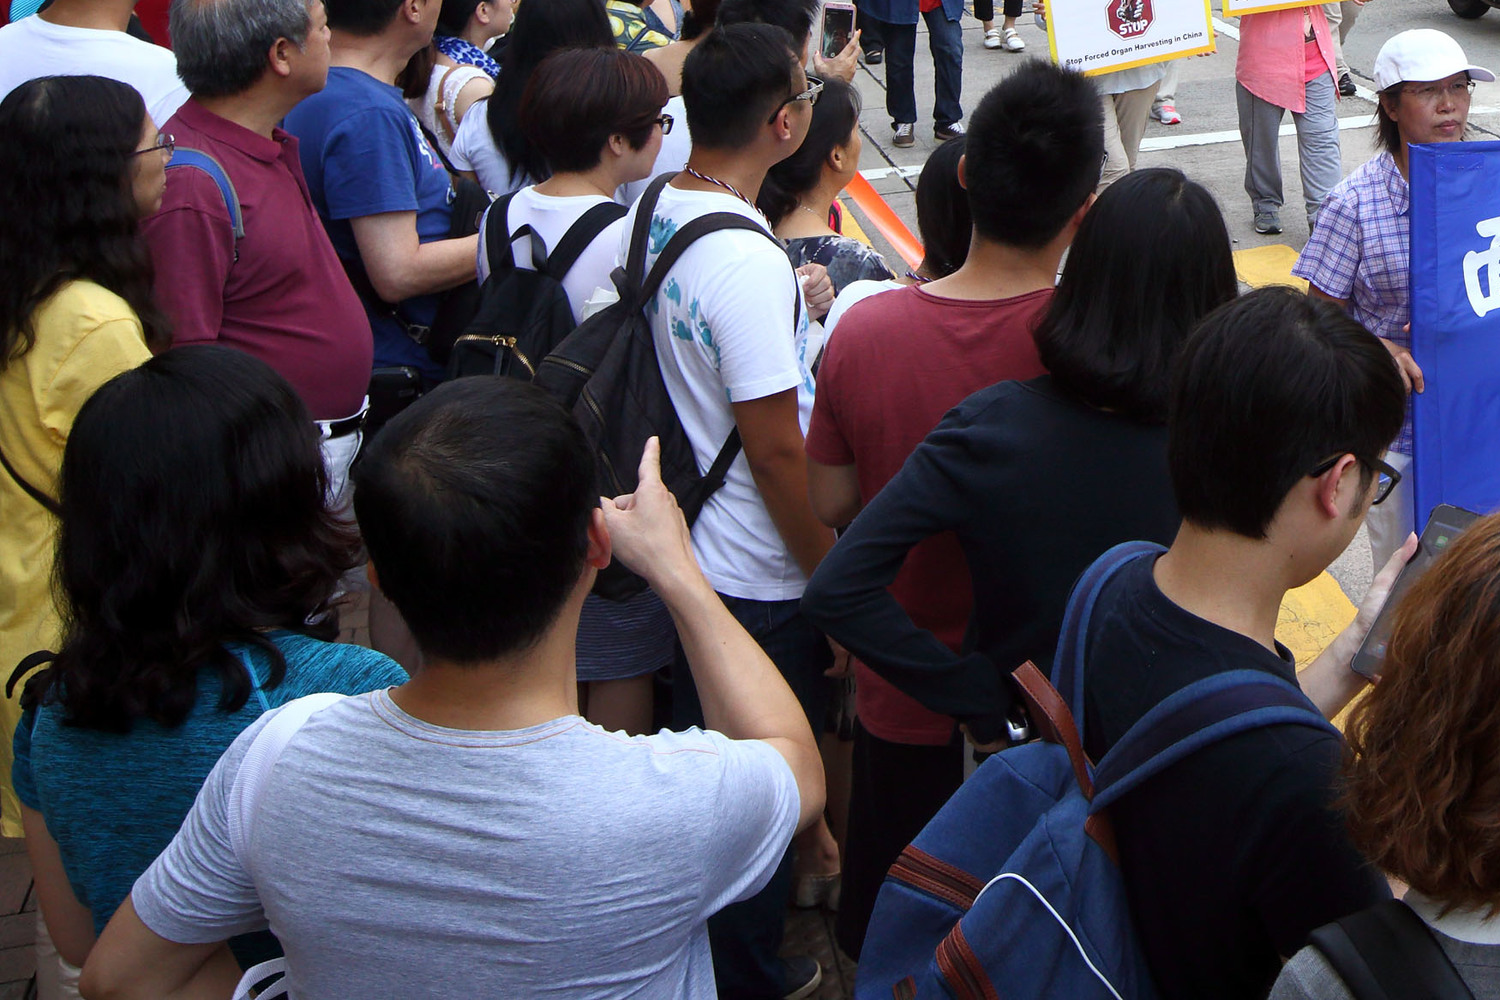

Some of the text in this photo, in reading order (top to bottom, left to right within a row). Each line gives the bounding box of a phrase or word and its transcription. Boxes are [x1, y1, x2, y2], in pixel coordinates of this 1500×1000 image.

[1065, 31, 1202, 66] Stop Forced Organ Harvesting in China
